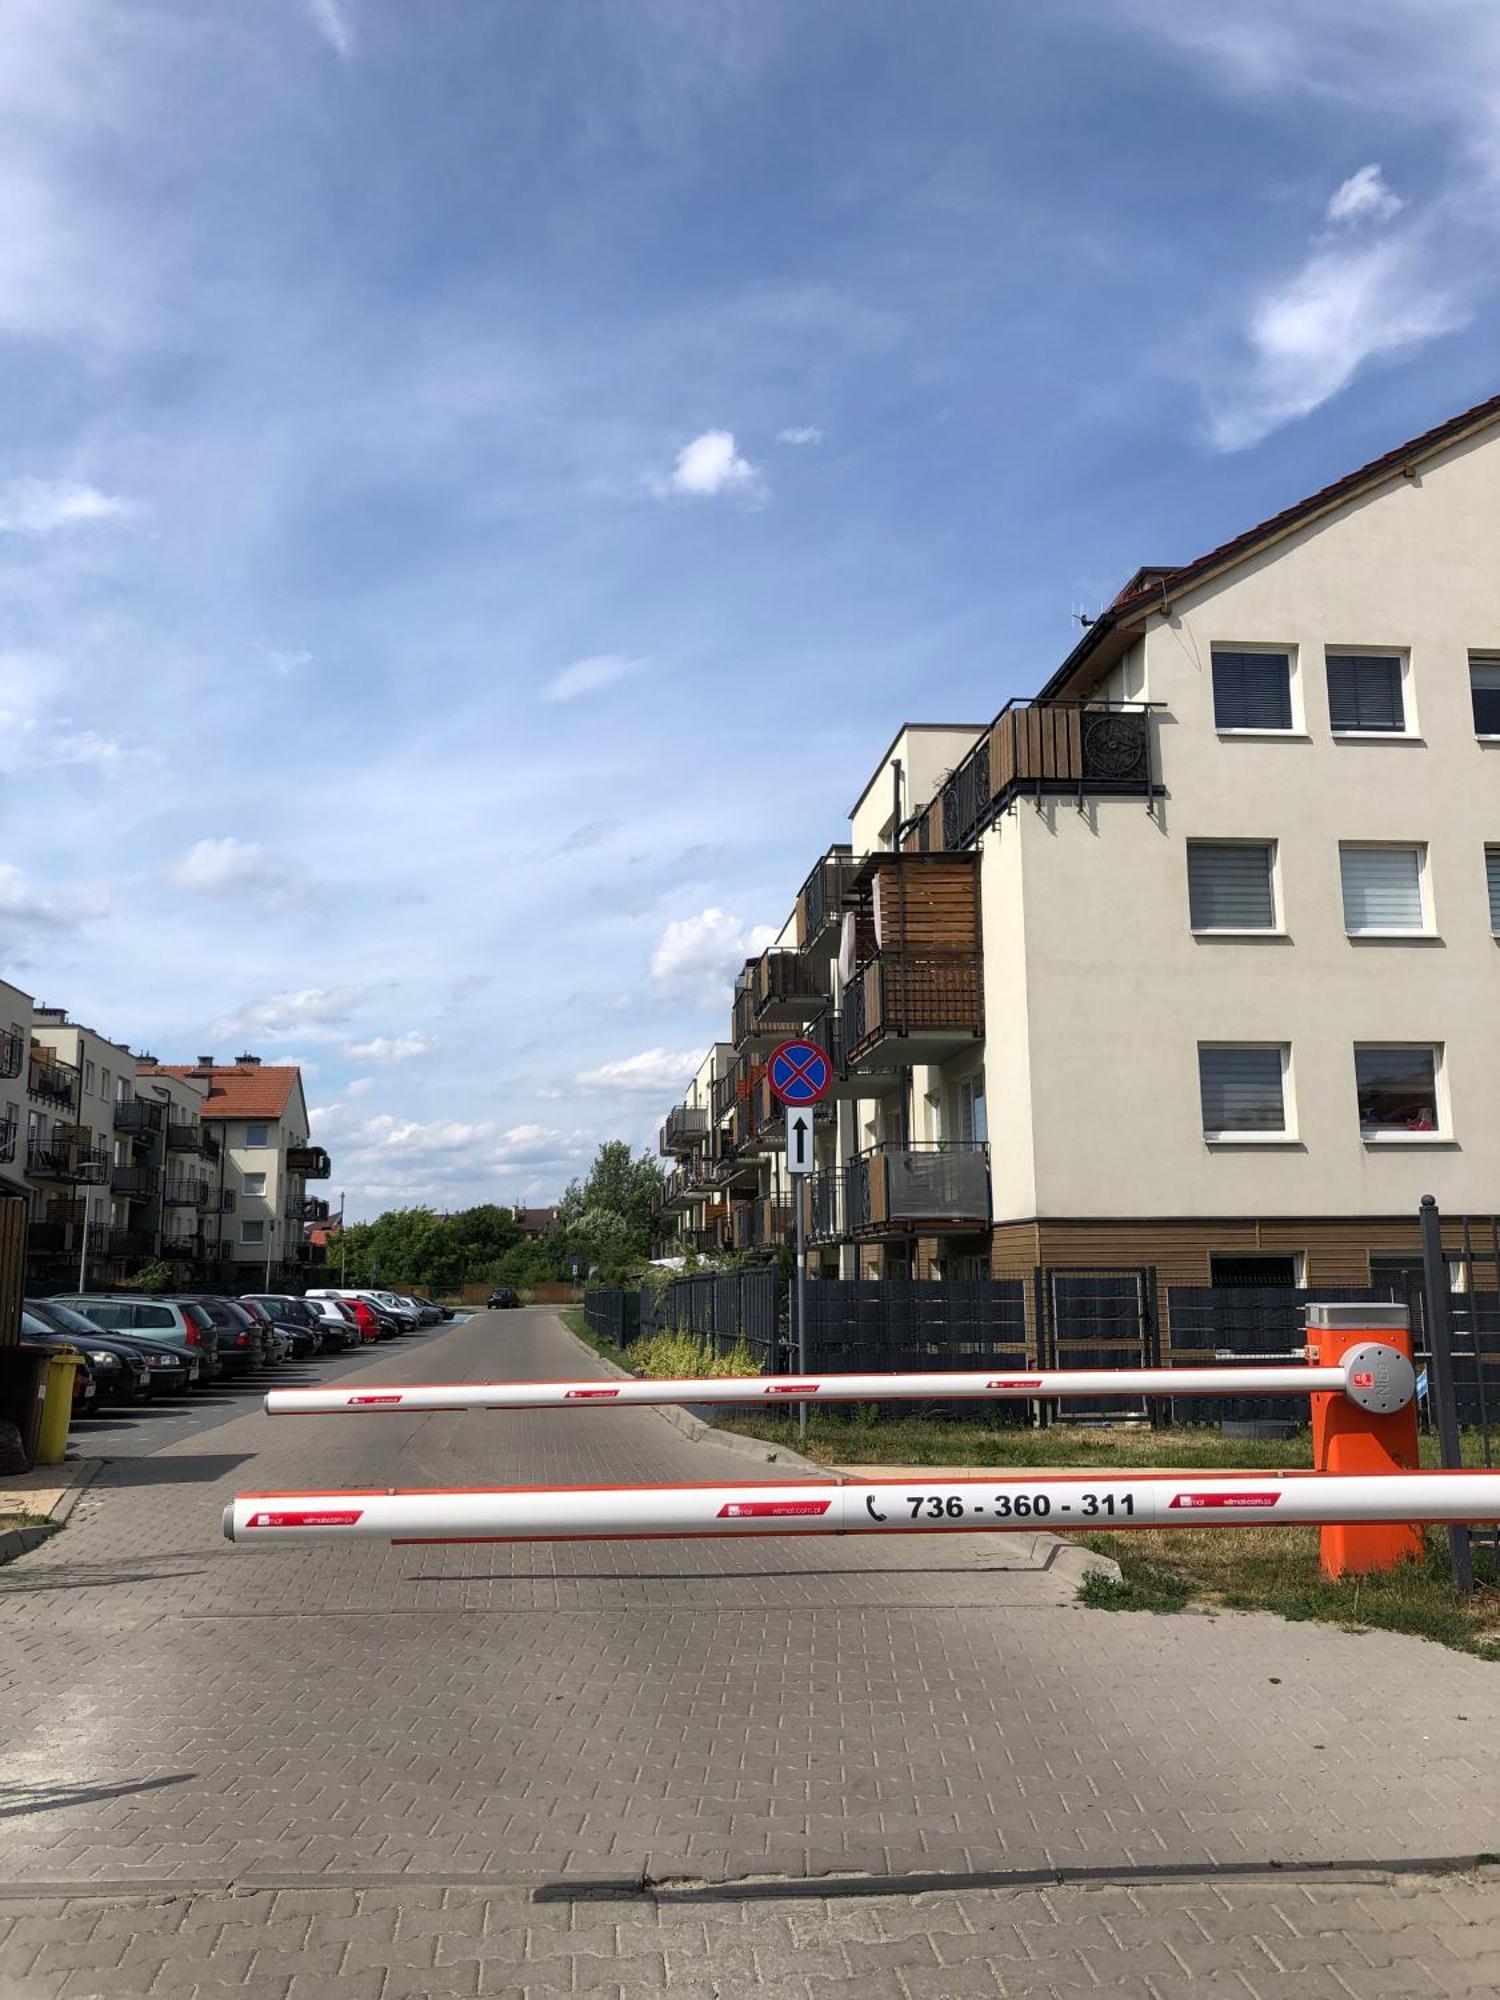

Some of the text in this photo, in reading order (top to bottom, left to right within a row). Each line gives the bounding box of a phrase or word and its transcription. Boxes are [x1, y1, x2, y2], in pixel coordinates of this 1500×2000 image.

[906, 1496, 964, 1519] 736
[994, 1495, 1051, 1517] 360
[1081, 1494, 1134, 1516] 311
